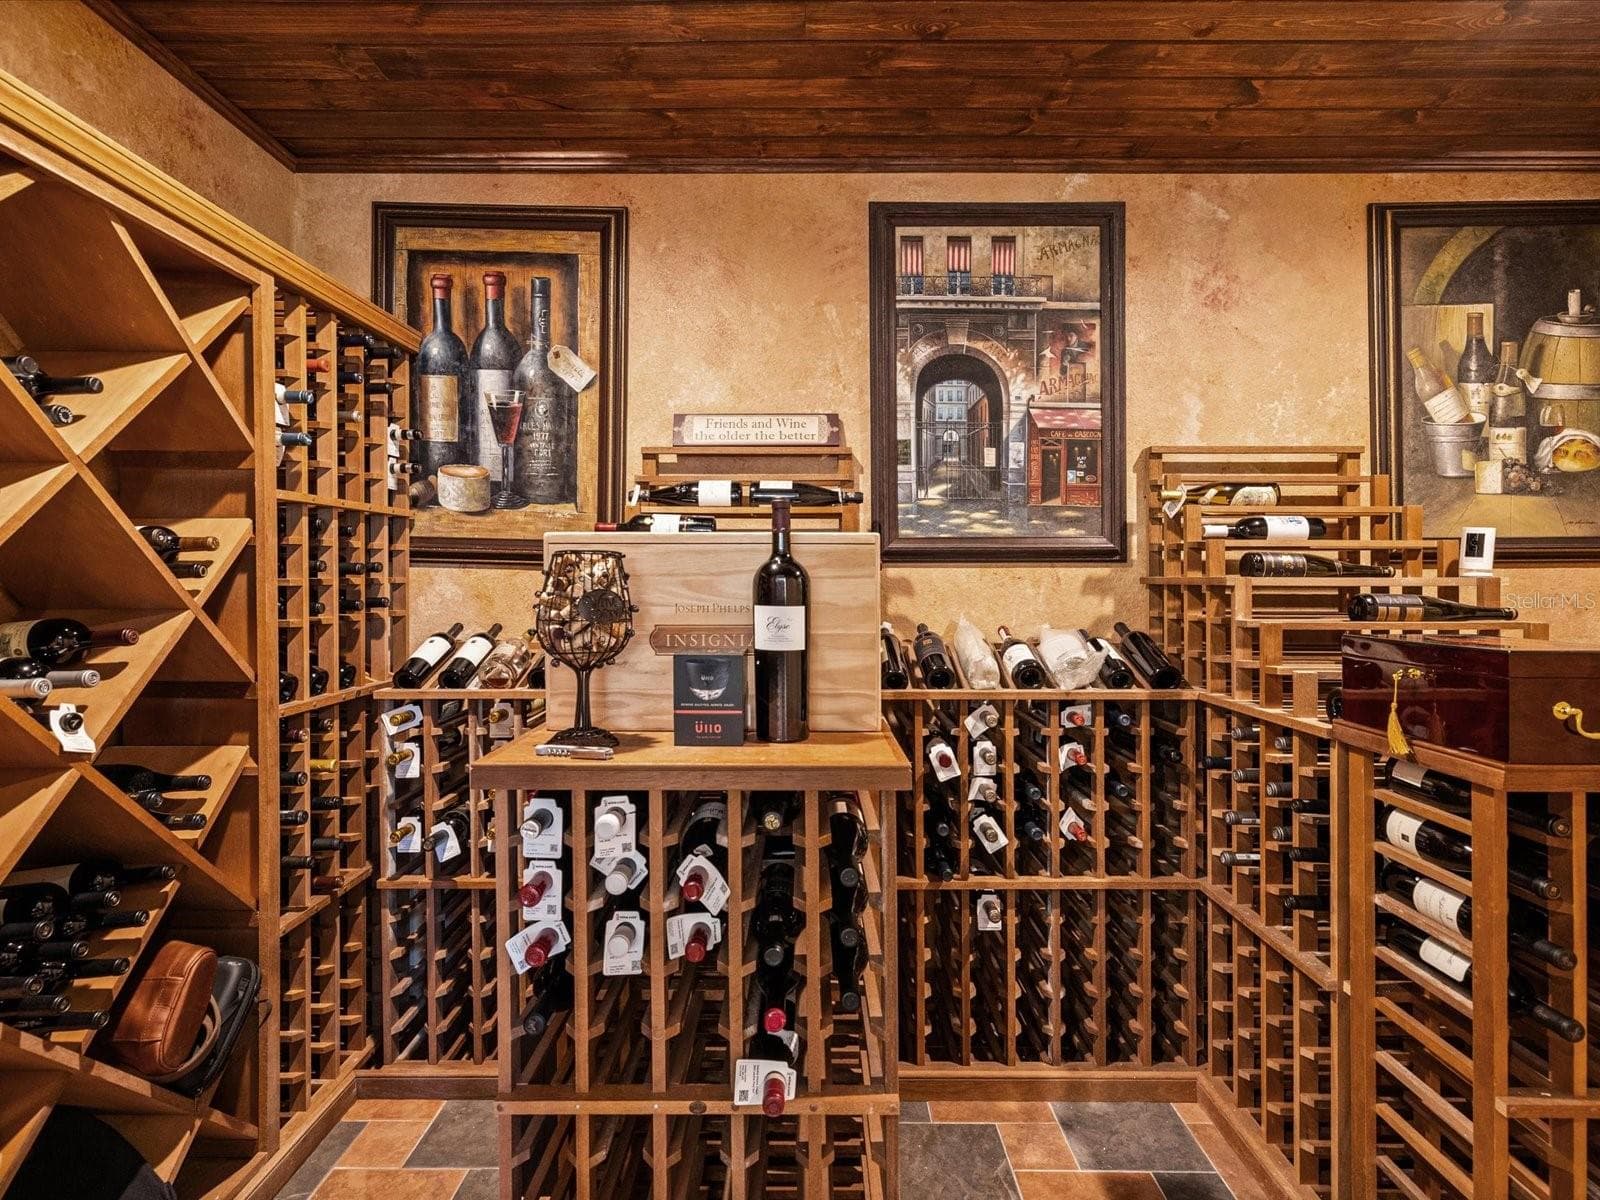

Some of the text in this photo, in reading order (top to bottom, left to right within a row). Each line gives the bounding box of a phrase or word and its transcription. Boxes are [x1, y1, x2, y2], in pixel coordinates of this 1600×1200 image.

[705, 418, 807, 429] Friends and Wine
[695, 431, 817, 441] the older the better
[675, 603, 750, 614] JOSEPH PHELPS
